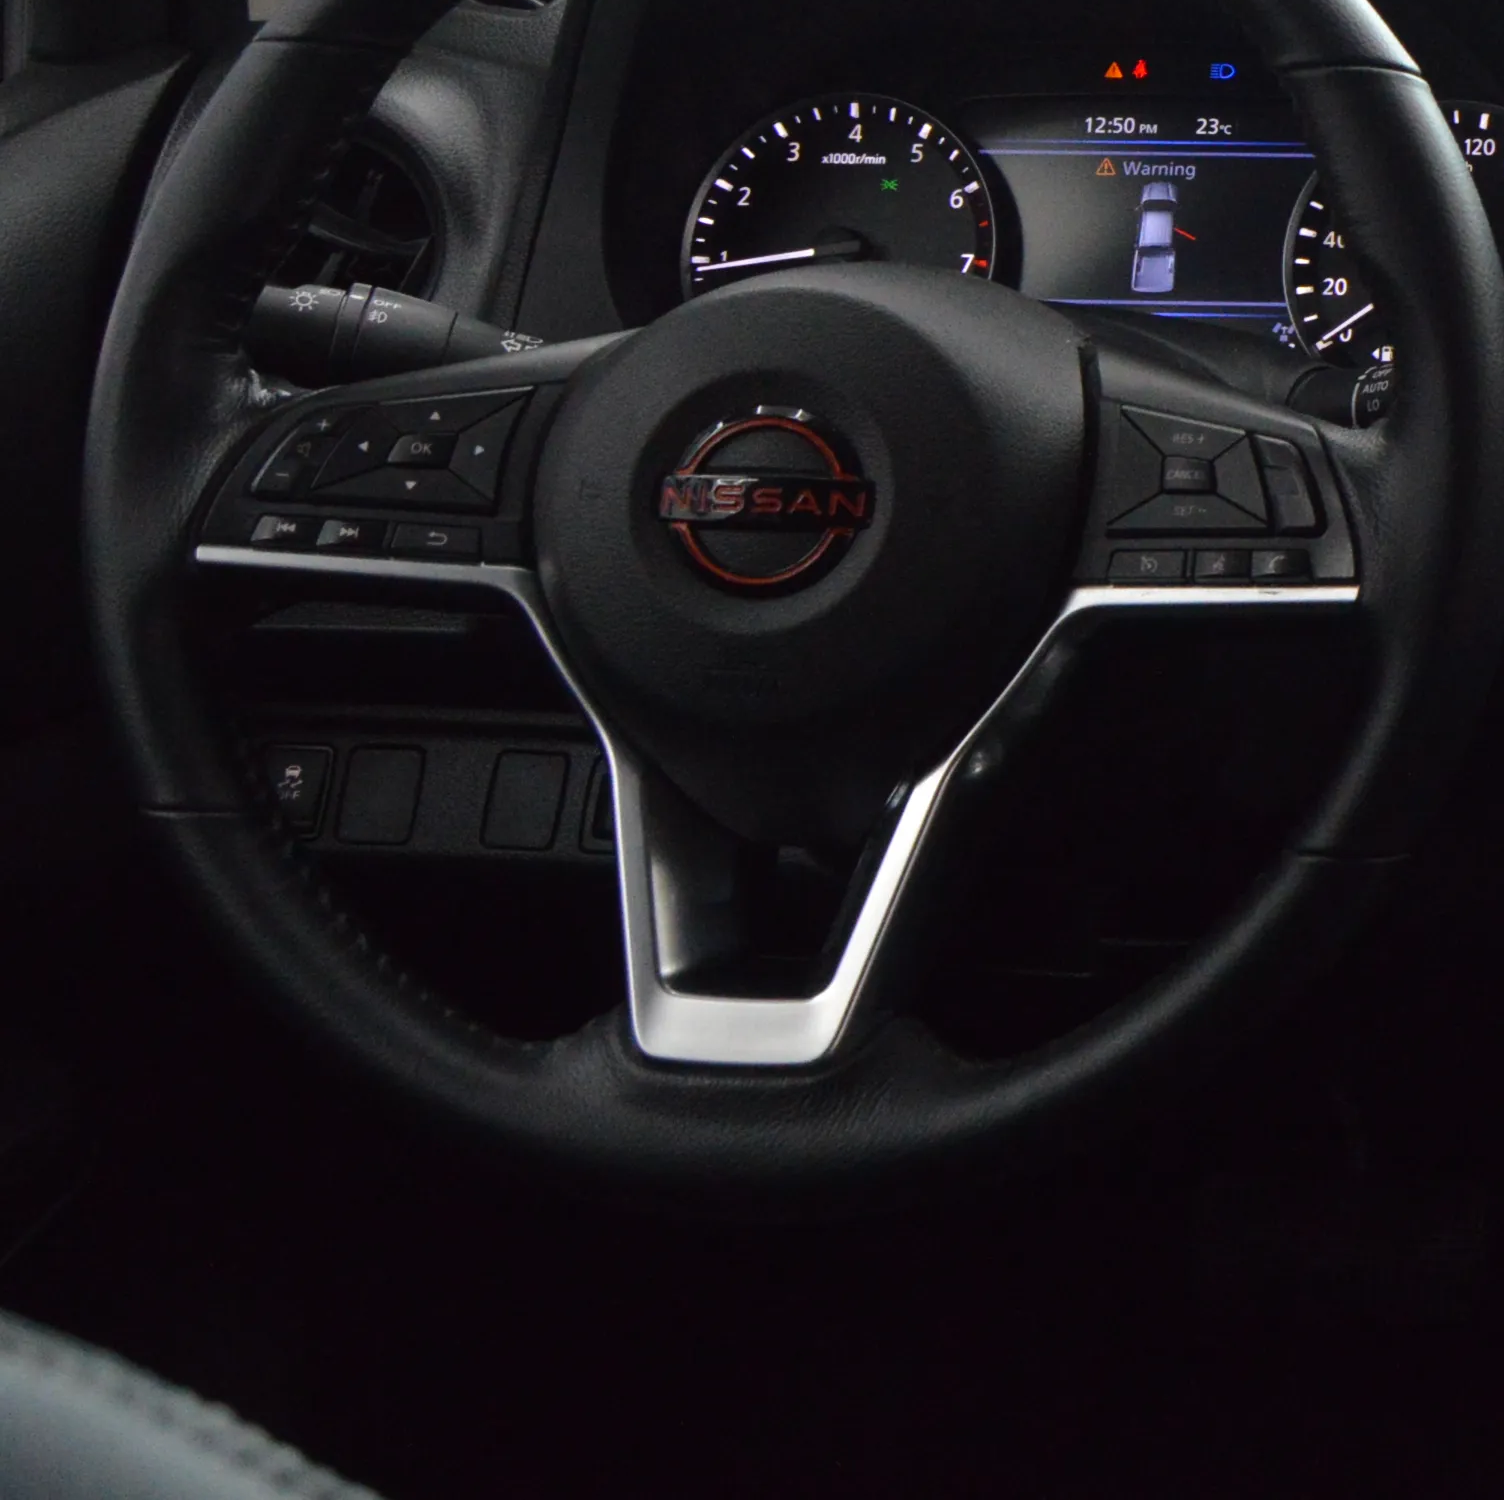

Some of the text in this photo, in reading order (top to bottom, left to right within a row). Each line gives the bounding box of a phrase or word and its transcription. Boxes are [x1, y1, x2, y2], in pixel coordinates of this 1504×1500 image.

[848, 122, 864, 143] 4
[1084, 116, 1158, 134] 12:50 PM
[786, 142, 801, 162] 3
[909, 143, 924, 163] 5
[1464, 138, 1496, 157] 120
[1122, 160, 1197, 180] Warning
[736, 186, 751, 206] 2
[949, 188, 964, 208] 6
[959, 252, 976, 275] 7
[1321, 277, 1348, 297] 20
[1361, 380, 1390, 395] AUTO
[1366, 398, 1381, 413] LO
[410, 441, 433, 455] OK
[659, 484, 868, 518] NISSAN
